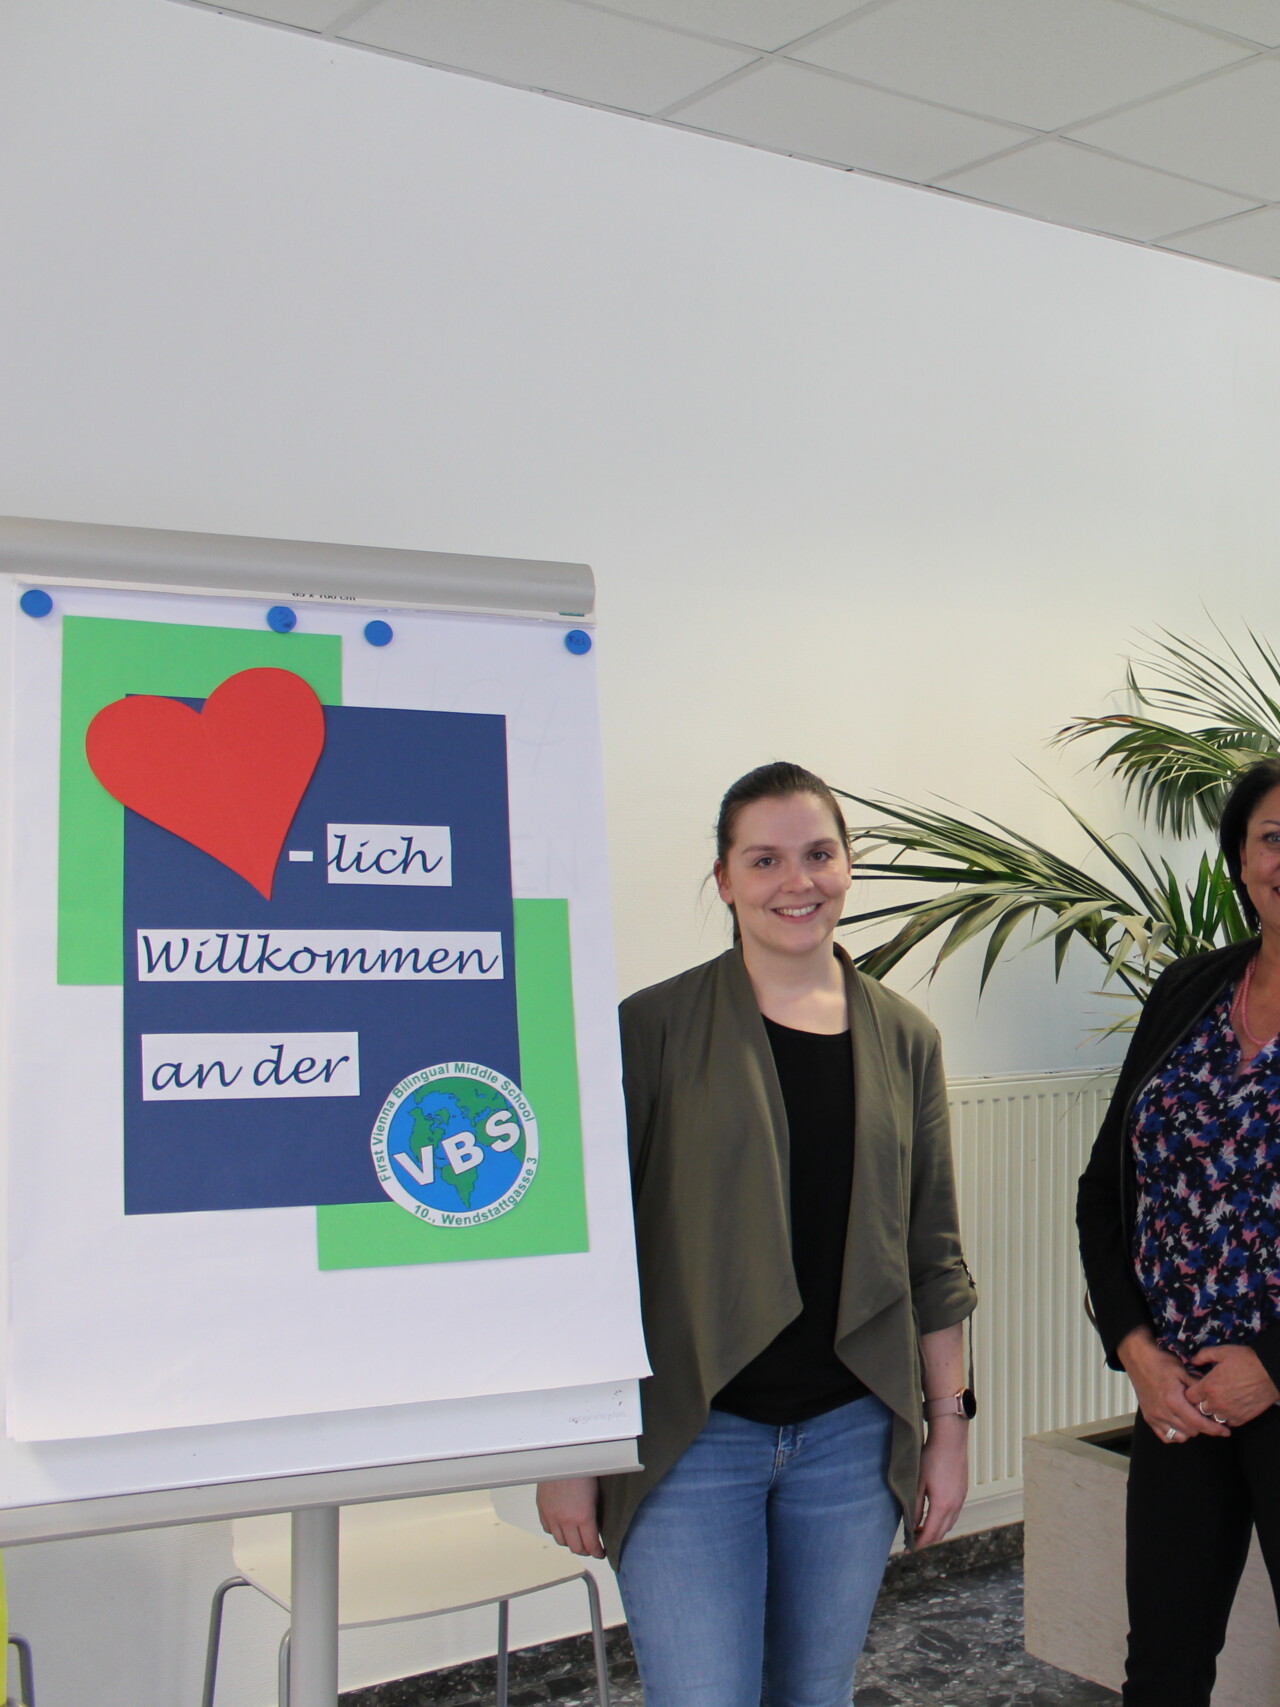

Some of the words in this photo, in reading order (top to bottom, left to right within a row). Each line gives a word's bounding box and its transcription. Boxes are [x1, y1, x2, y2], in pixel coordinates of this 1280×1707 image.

[142, 932, 499, 974] Willkommen
[151, 1060, 242, 1092] an
[252, 1043, 350, 1086] der
[393, 1062, 450, 1099] Bilingual
[454, 1062, 499, 1085] Middle
[501, 1080, 536, 1122] School
[372, 1099, 396, 1146] Vienna
[375, 1149, 391, 1183] First
[441, 1168, 534, 1226] Wendstattgasse
[526, 1156, 537, 1165] 3
